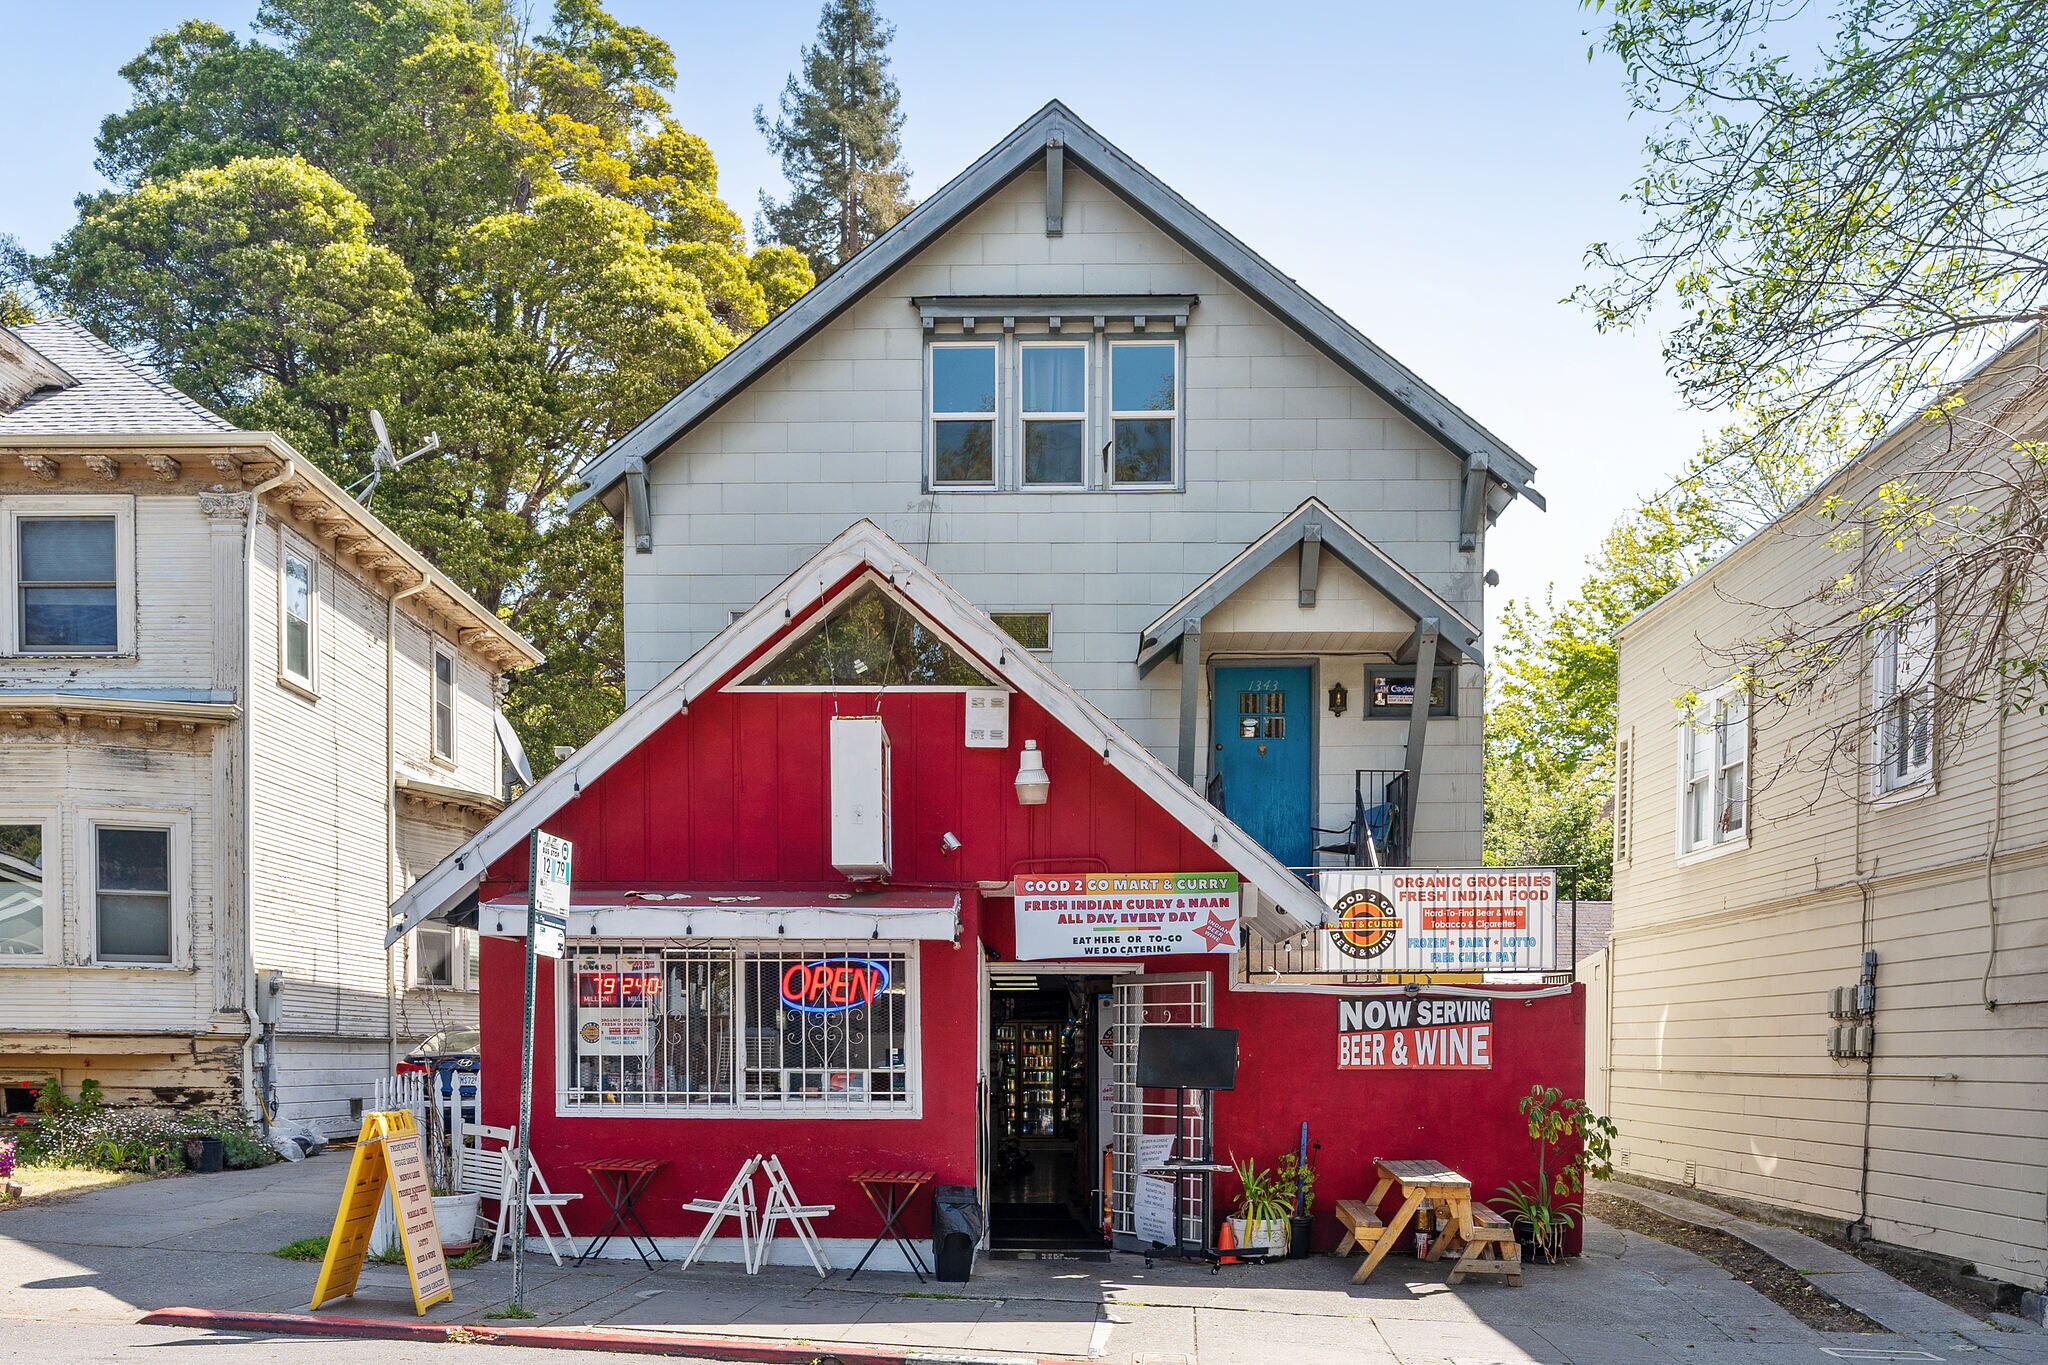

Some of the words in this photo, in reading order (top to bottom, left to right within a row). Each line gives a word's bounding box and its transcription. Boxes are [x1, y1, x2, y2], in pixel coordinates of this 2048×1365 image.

[1248, 680, 1278, 690] 1343
[551, 850, 560, 858] STOP
[544, 857, 550, 874] 12
[557, 861, 565, 877] 79
[1024, 880, 1070, 892] GOOD
[1074, 880, 1083, 891] 2
[1087, 880, 1109, 891] GO
[1114, 879, 1158, 890] MART
[1164, 879, 1173, 890] &
[1176, 878, 1229, 889] CURRY
[1394, 877, 1462, 888] ORGANIC
[1466, 876, 1551, 887] GROCERIES
[1399, 892, 1447, 902] FRESH
[1452, 891, 1505, 901] INDIAN
[1509, 891, 1549, 901] FOOD
[1024, 900, 1068, 911] FRESH
[1072, 899, 1122, 910] INDIAN
[1126, 899, 1172, 909] CURRY
[1176, 898, 1186, 908] &
[1189, 898, 1230, 908] NAAN
[1380, 901, 1394, 915] GO
[1058, 914, 1083, 924] ALL
[1087, 913, 1117, 924] DAY,
[1121, 912, 1165, 923] EVERY
[1169, 912, 1197, 922] DAY
[1424, 908, 1475, 917] Hard-To-Find
[1476, 908, 1494, 917] Beer
[1496, 908, 1502, 917] &
[1503, 908, 1523, 916] Wine
[1206, 925, 1223, 937] BEER
[1208, 919, 1230, 934] INDIAN
[1431, 920, 1466, 928] Tobacco
[1475, 920, 1516, 930] Cigarettes
[1072, 937, 1091, 945] EAT
[1204, 930, 1220, 942] WINE
[1332, 933, 1356, 955] BEER
[1369, 932, 1394, 955] WINE
[1408, 938, 1447, 948] FROZEN
[1458, 937, 1490, 948] DAIRY
[1503, 937, 1536, 947] LOTTO
[1120, 945, 1171, 954] CATERING
[1430, 953, 1456, 963] FREE
[1458, 953, 1493, 962] CHECK
[1496, 952, 1517, 962] PAY
[782, 964, 879, 1004] OPEN
[1340, 1001, 1411, 1031] NOW
[1417, 1000, 1490, 1025] SERVING
[1340, 1033, 1385, 1066] BEER
[1391, 1031, 1408, 1066] &
[1415, 1026, 1489, 1066] WINE
